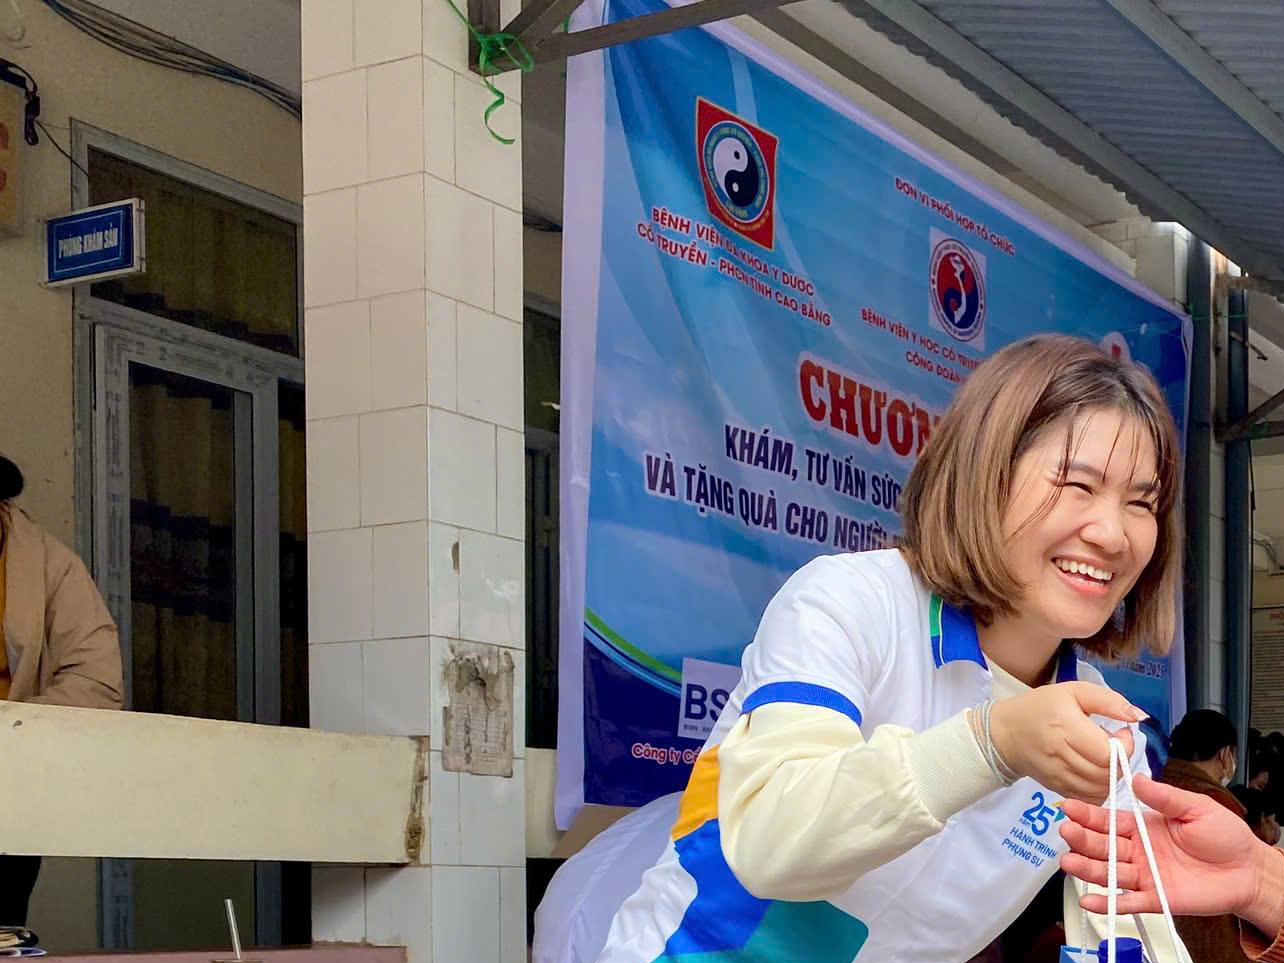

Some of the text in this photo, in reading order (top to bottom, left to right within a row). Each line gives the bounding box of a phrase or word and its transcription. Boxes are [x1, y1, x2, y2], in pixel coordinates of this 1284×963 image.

[652, 206, 691, 234] BỆNH
[695, 223, 724, 248] VIỆN
[739, 251, 769, 276] KHOA
[771, 266, 779, 280] Y
[657, 233, 708, 267] TRUYỀN
[719, 258, 750, 286] PHCN
[774, 290, 798, 312] CAO
[801, 300, 832, 327] BẰNG
[861, 308, 886, 331] BỆNH
[888, 320, 910, 340] VIỆN
[911, 330, 918, 344] Y
[919, 334, 940, 355] HỌC
[906, 350, 933, 373] CÔNG
[800, 359, 942, 457] CHƯƠN
[724, 424, 798, 481] KHÁM,
[805, 449, 830, 486] TƯ
[832, 456, 867, 501] VẤN
[646, 453, 676, 497] VÀ
[683, 463, 735, 513] TẶNG
[739, 490, 778, 531] QUÀ
[785, 502, 829, 543] CHO
[685, 683, 730, 722] BS
[632, 743, 667, 764] Công
[669, 747, 681, 765] ty
[1022, 791, 1056, 836] 25
[1001, 837, 1032, 861] PHỤNG
[1010, 826, 1058, 860] HÀNH TRÌNH
